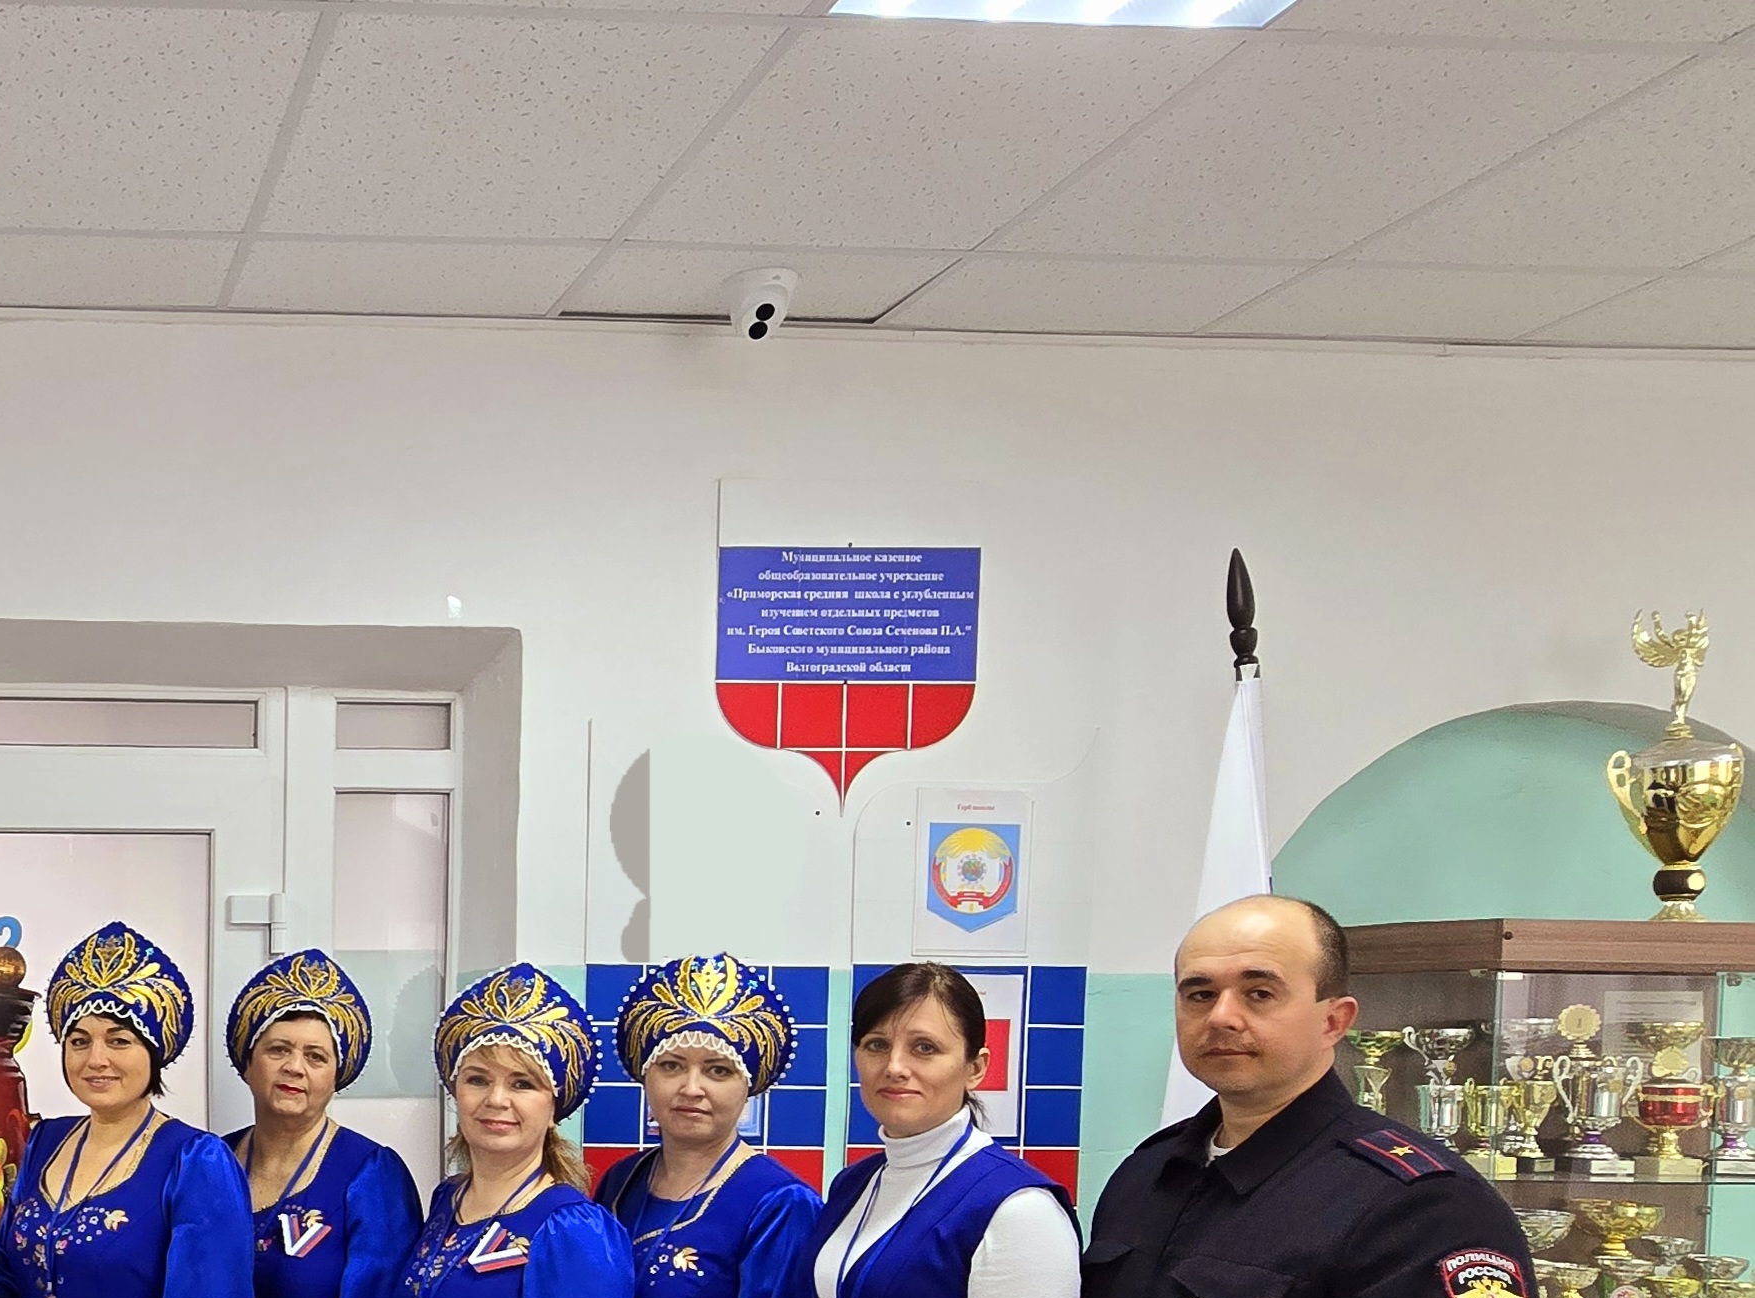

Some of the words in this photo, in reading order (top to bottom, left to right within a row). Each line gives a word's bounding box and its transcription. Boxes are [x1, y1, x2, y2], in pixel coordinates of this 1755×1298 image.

[781, 551, 871, 564] Муниципальное
[874, 554, 922, 562] казенное
[758, 570, 877, 583] общеобразовательное
[879, 573, 944, 583] учреждение
[804, 591, 848, 601] средняя
[854, 591, 891, 599] школа
[893, 591, 900, 599] с
[761, 609, 818, 619] изучением
[821, 609, 880, 618] отдельных
[884, 609, 940, 619] предметов
[726, 627, 746, 636] им.
[748, 625, 781, 638] Героя
[783, 625, 845, 636] Советского
[847, 625, 883, 636] Союза
[886, 625, 938, 636] Семенова
[748, 643, 813, 654] Быковского
[816, 645, 909, 656] муниципального
[910, 643, 951, 656] района
[786, 661, 866, 675] Волгоградской
[869, 661, 911, 673] области
[1446, 1253, 1516, 1272] ПОЛИЦИЯ
[1458, 1266, 1512, 1284] РОССИЯ
